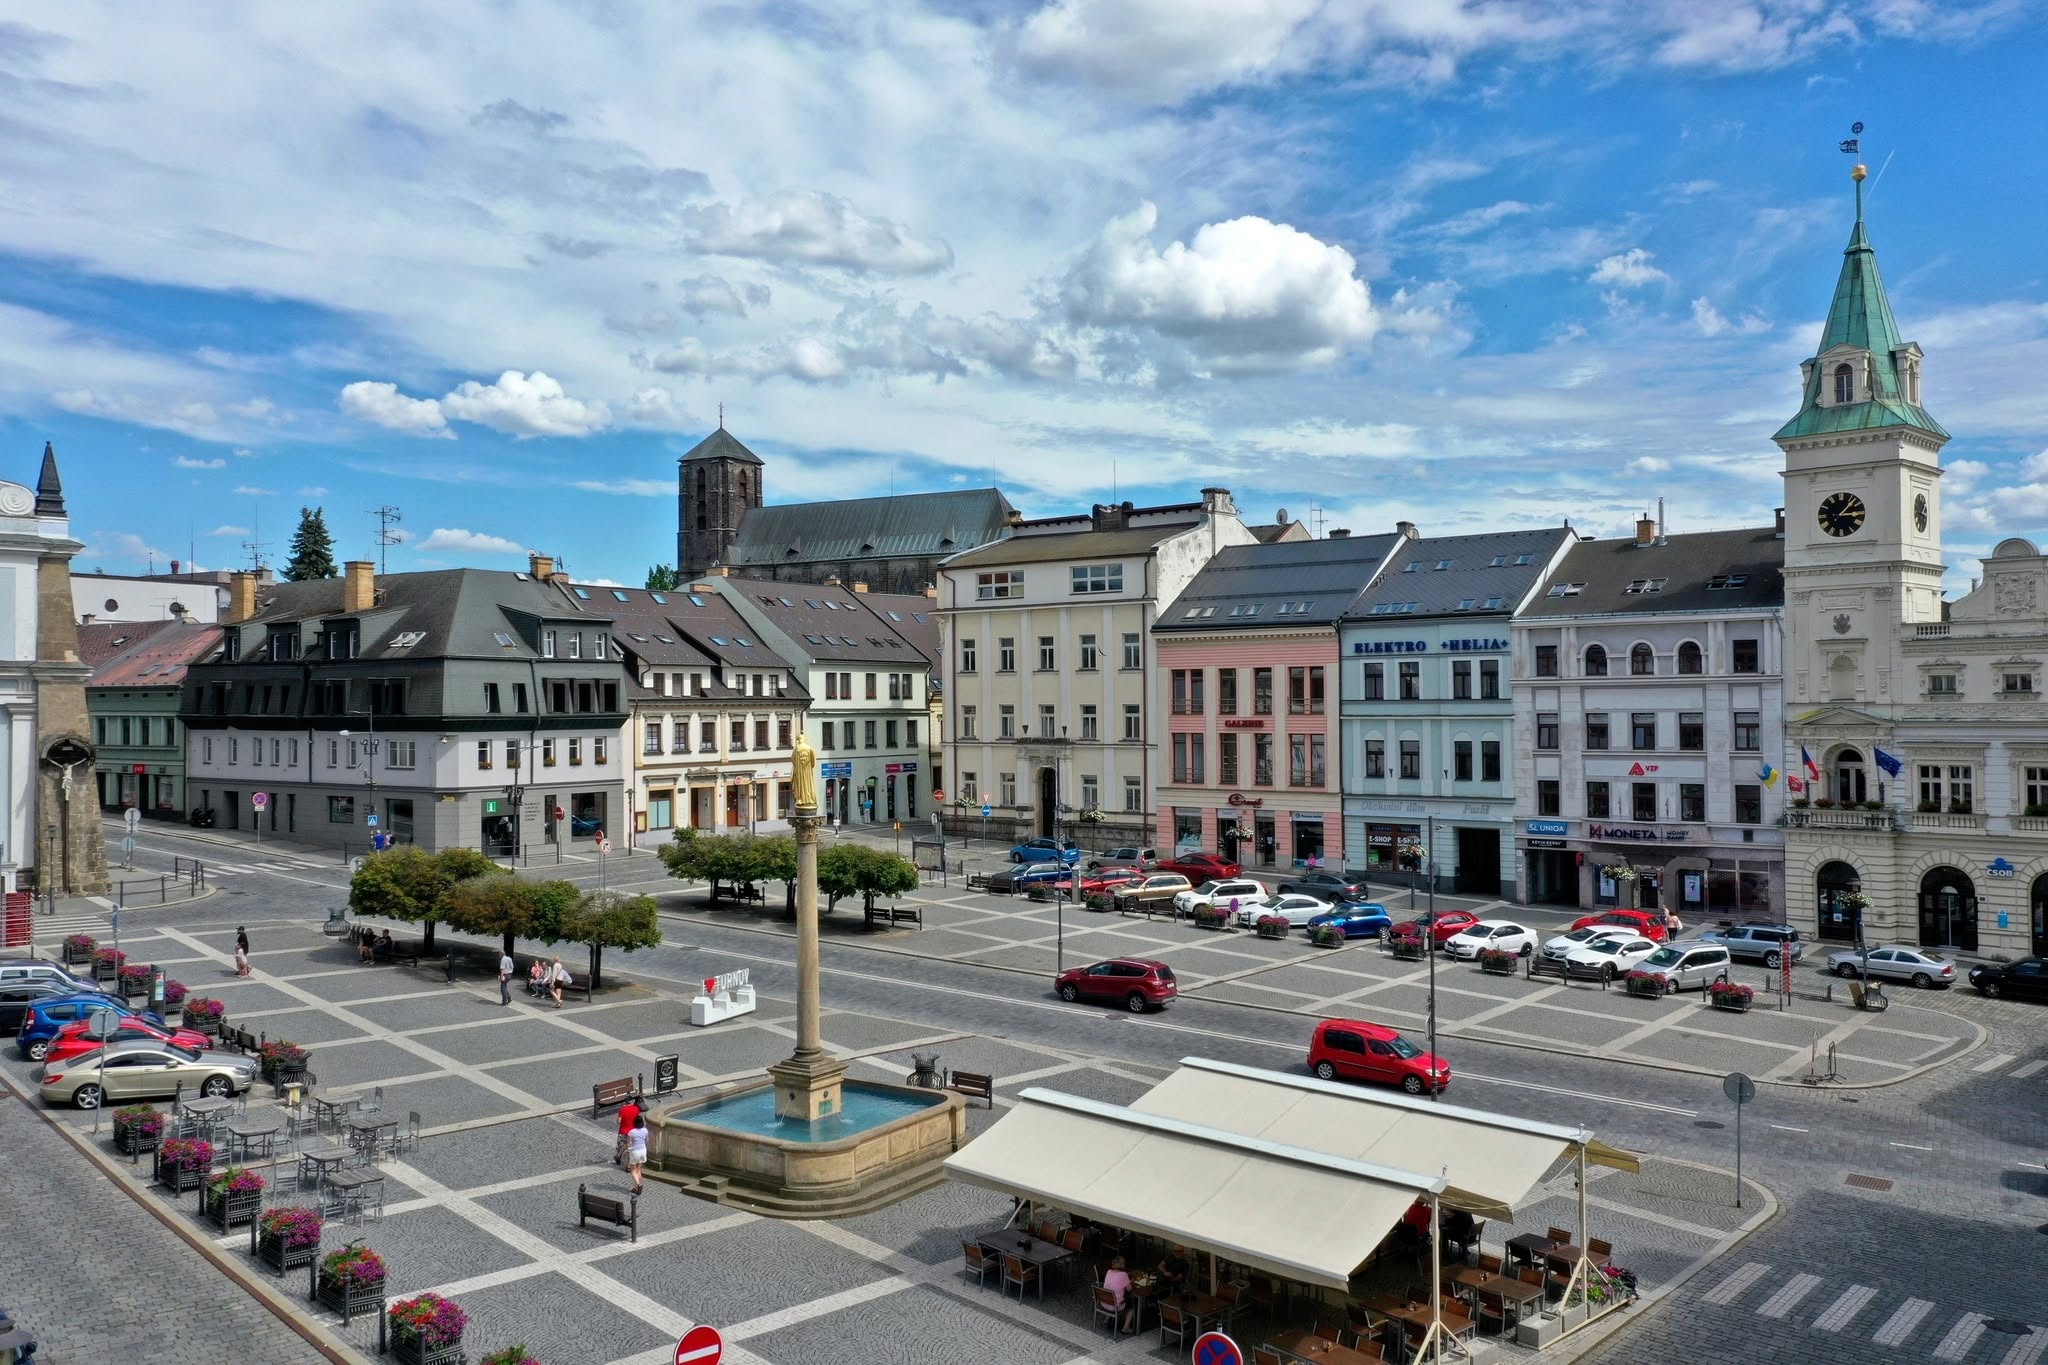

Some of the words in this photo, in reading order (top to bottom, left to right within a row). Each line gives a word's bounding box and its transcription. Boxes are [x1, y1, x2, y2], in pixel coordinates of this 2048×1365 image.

[1354, 641, 1427, 653] ELEKTRO
[1449, 639, 1501, 651] HELIA
[1368, 835, 1392, 843] E-SHOP
[1604, 827, 1657, 840] MONETA
[714, 968, 750, 992] TURNOV
